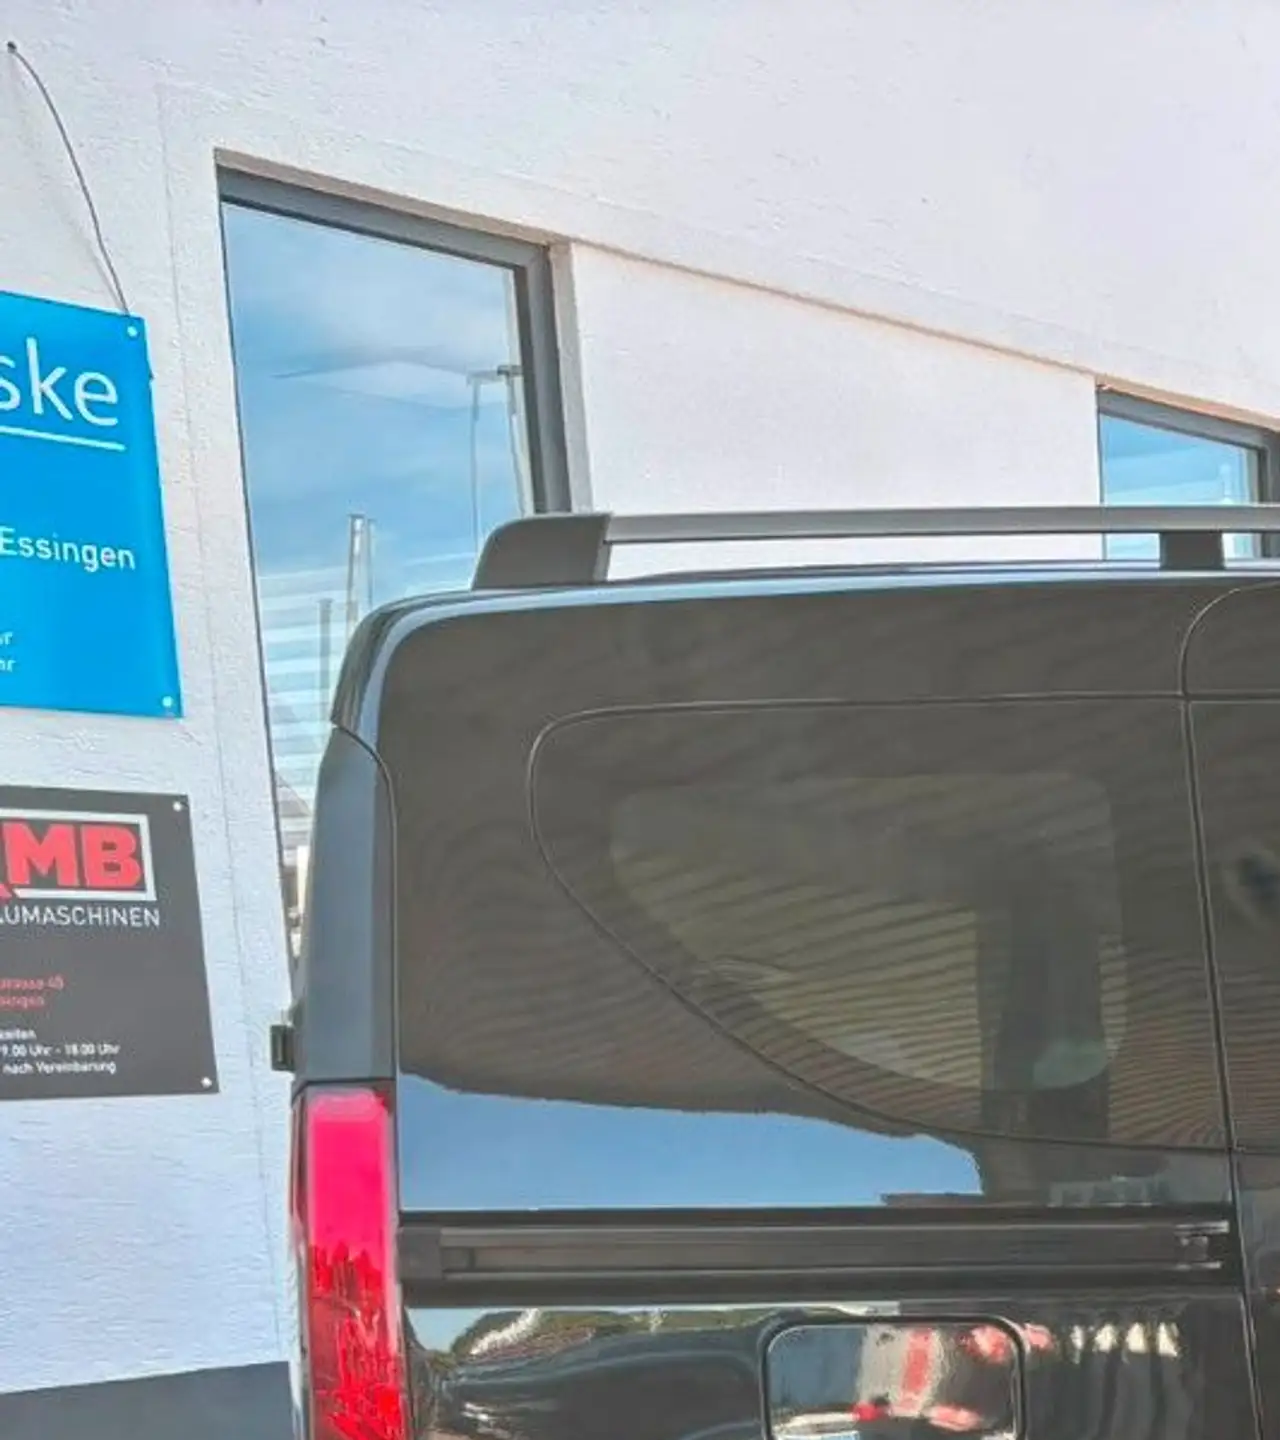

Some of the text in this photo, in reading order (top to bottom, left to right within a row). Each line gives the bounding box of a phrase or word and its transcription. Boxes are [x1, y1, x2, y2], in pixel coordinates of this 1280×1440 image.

[0, 526, 136, 572] Essingen
[0, 820, 142, 889] MB
[0, 905, 160, 927] UMASCHINEN
